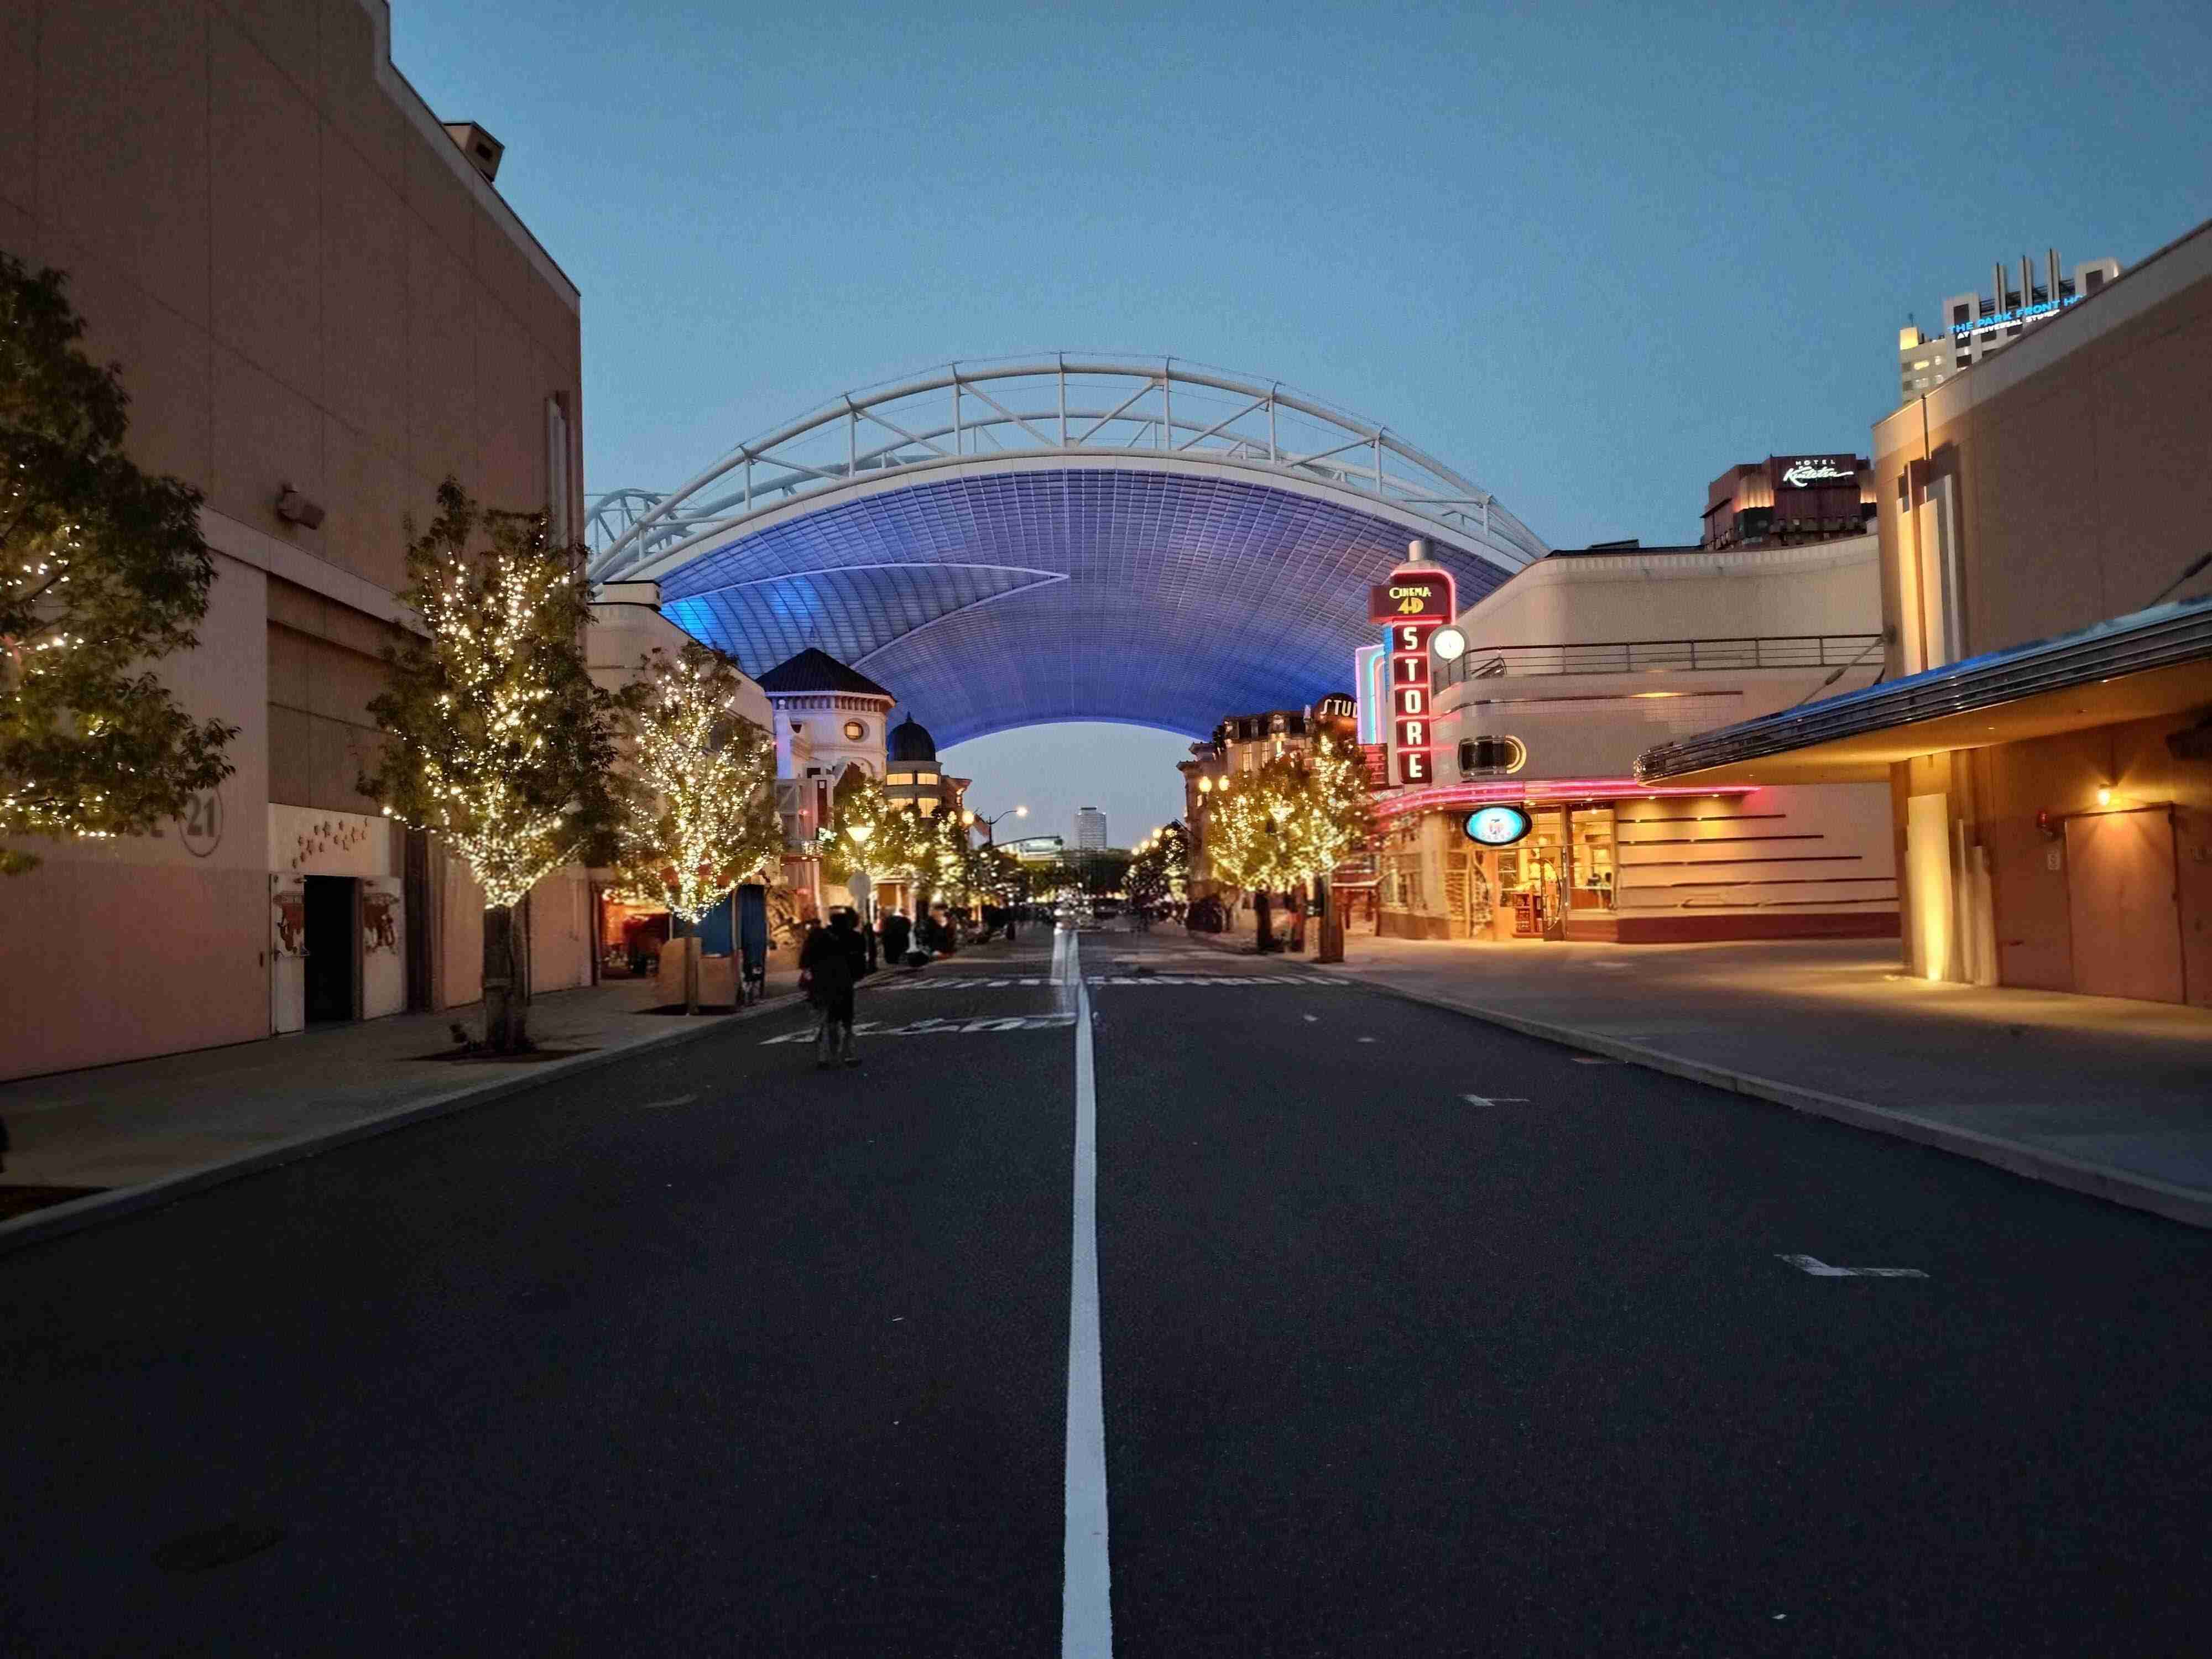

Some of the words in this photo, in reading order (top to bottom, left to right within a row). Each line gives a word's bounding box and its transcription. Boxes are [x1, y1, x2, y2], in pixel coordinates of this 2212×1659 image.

[1947, 321, 1974, 335] THE
[1977, 311, 2012, 327] PARK
[2016, 300, 2060, 316] FRONT
[1957, 331, 1970, 339] AT
[1397, 597, 1424, 614] 4D
[1403, 626, 1423, 778] STORE
[184, 792, 215, 837] 21
